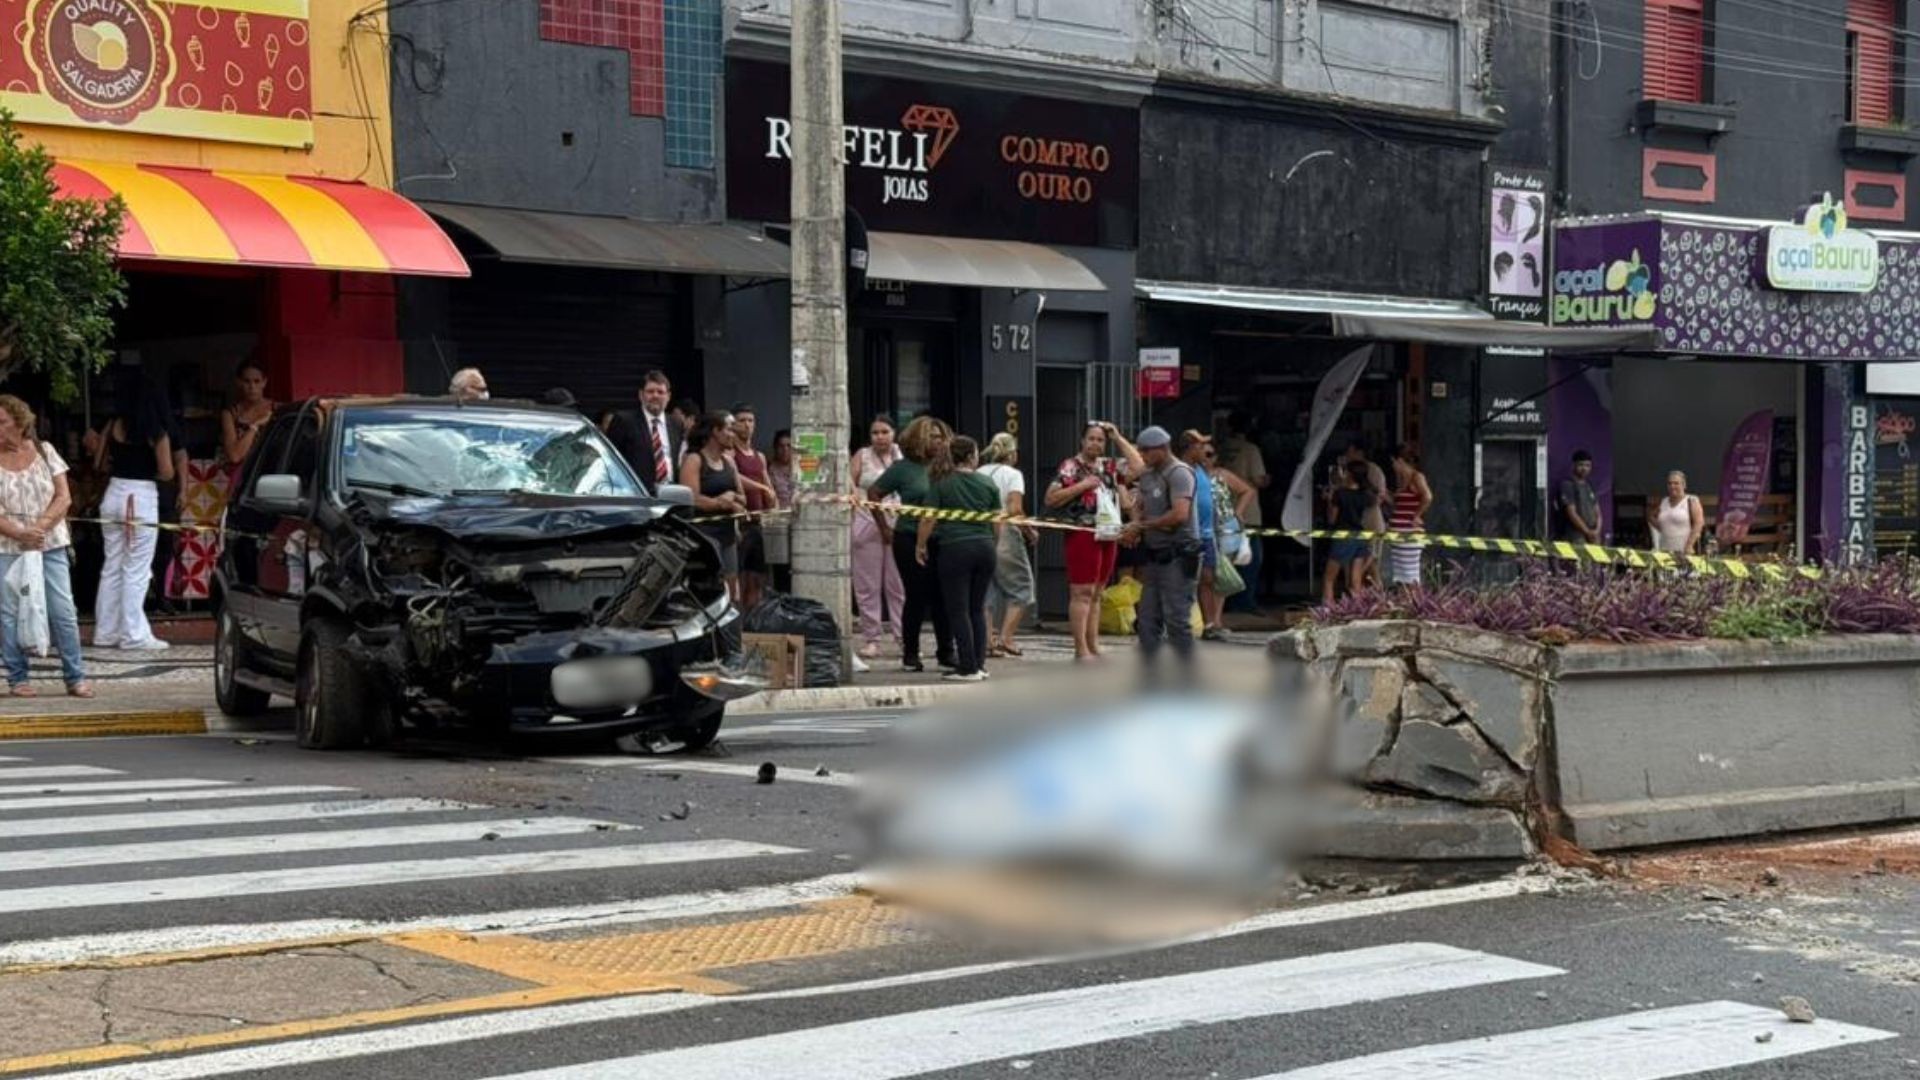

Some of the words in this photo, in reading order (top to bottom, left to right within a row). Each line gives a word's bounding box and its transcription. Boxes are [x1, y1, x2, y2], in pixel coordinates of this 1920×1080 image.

[64, 0, 136, 25] QUALITY
[61, 60, 144, 98] SALGADERIA
[765, 116, 929, 172] RFELI
[1001, 135, 1110, 172] COMPRO
[883, 176, 929, 204] JOIAS
[1018, 172, 1092, 203] OURO
[1555, 262, 1606, 295] açaí
[1489, 297, 1543, 319] Tranças
[1554, 293, 1633, 323] Bauru
